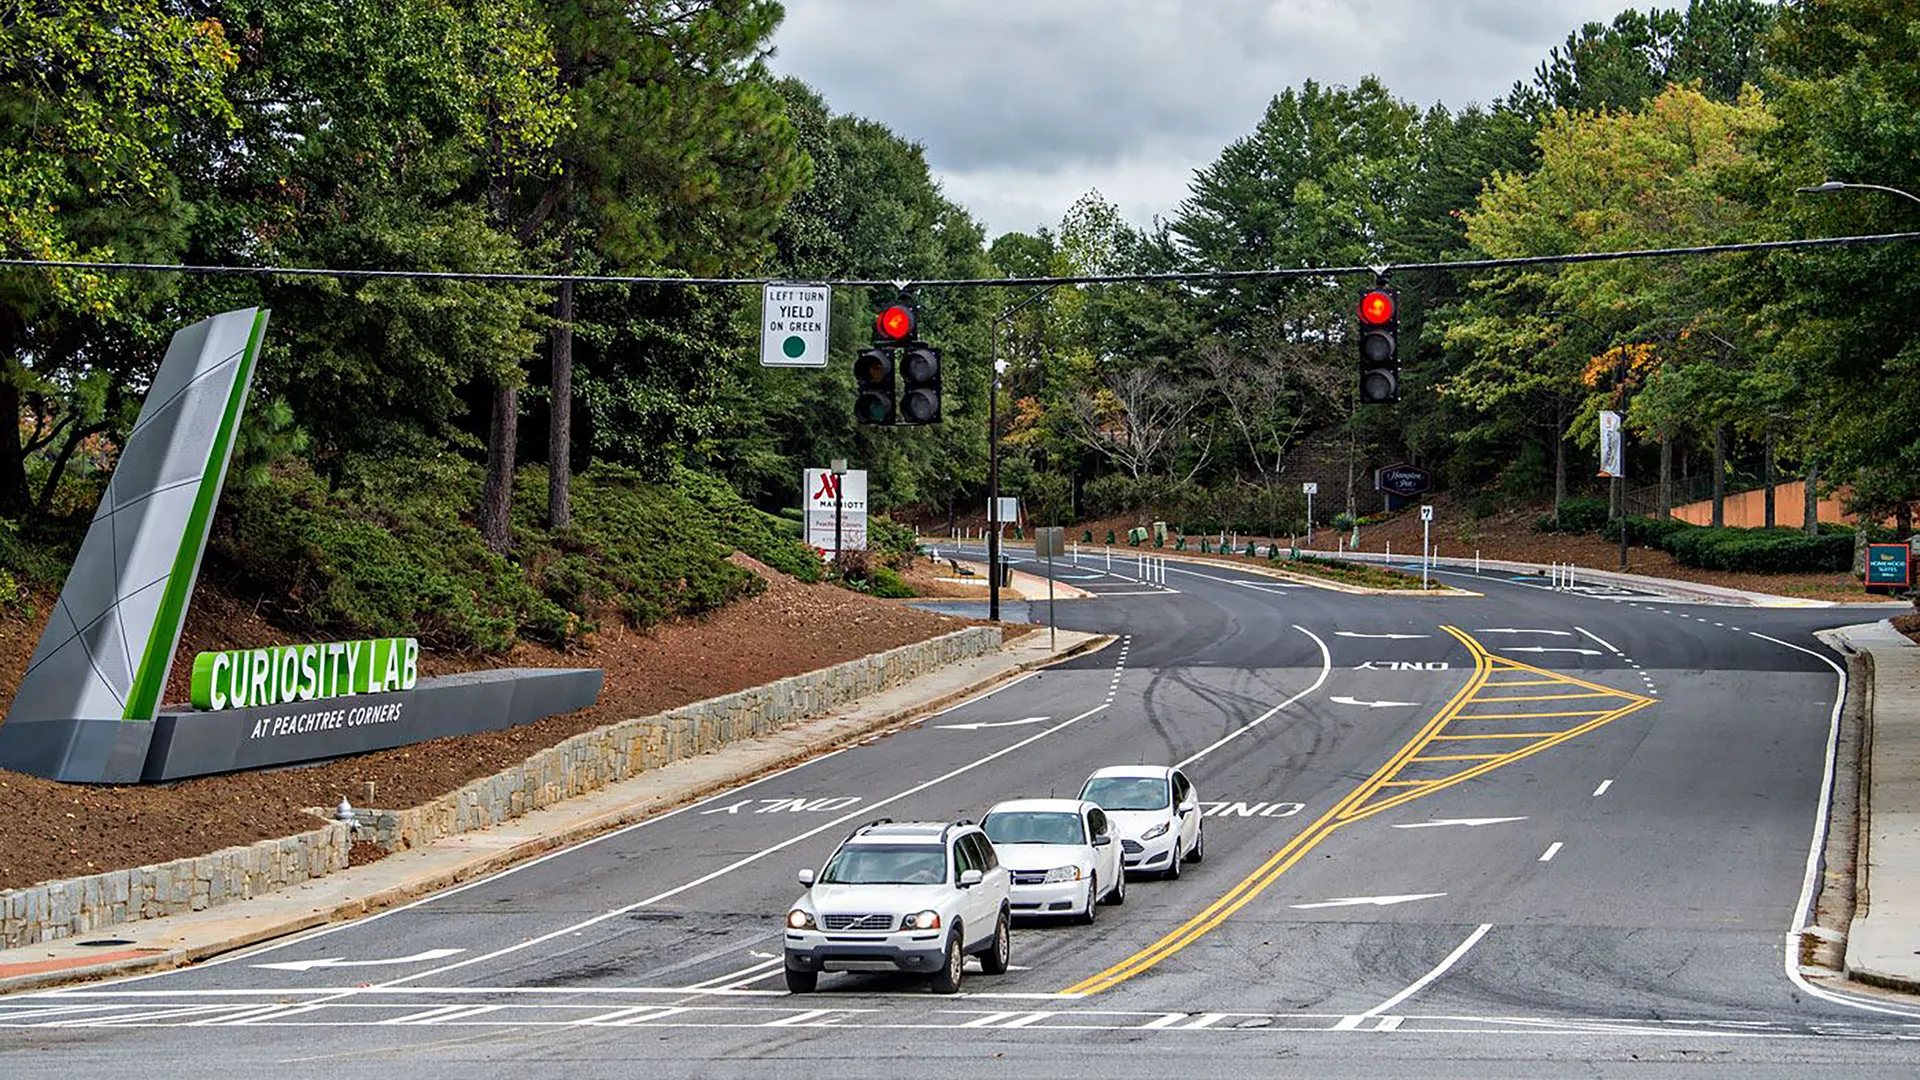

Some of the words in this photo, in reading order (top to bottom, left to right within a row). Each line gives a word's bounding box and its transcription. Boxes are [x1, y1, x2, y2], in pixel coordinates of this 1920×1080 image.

[770, 291, 793, 301] LEFT
[800, 291, 824, 301] TURN
[780, 306, 814, 318] YIELD
[770, 321, 783, 331] ON
[789, 321, 821, 332] GREEN
[1352, 661, 1449, 671] ONLY
[210, 642, 361, 710] CURIOSITY
[368, 638, 418, 693] LAB
[251, 719, 271, 739] AT
[272, 710, 346, 736] PEACHTREE
[347, 703, 403, 727] CORNERS
[699, 797, 862, 814] ONLY
[1199, 802, 1306, 817] ONL
